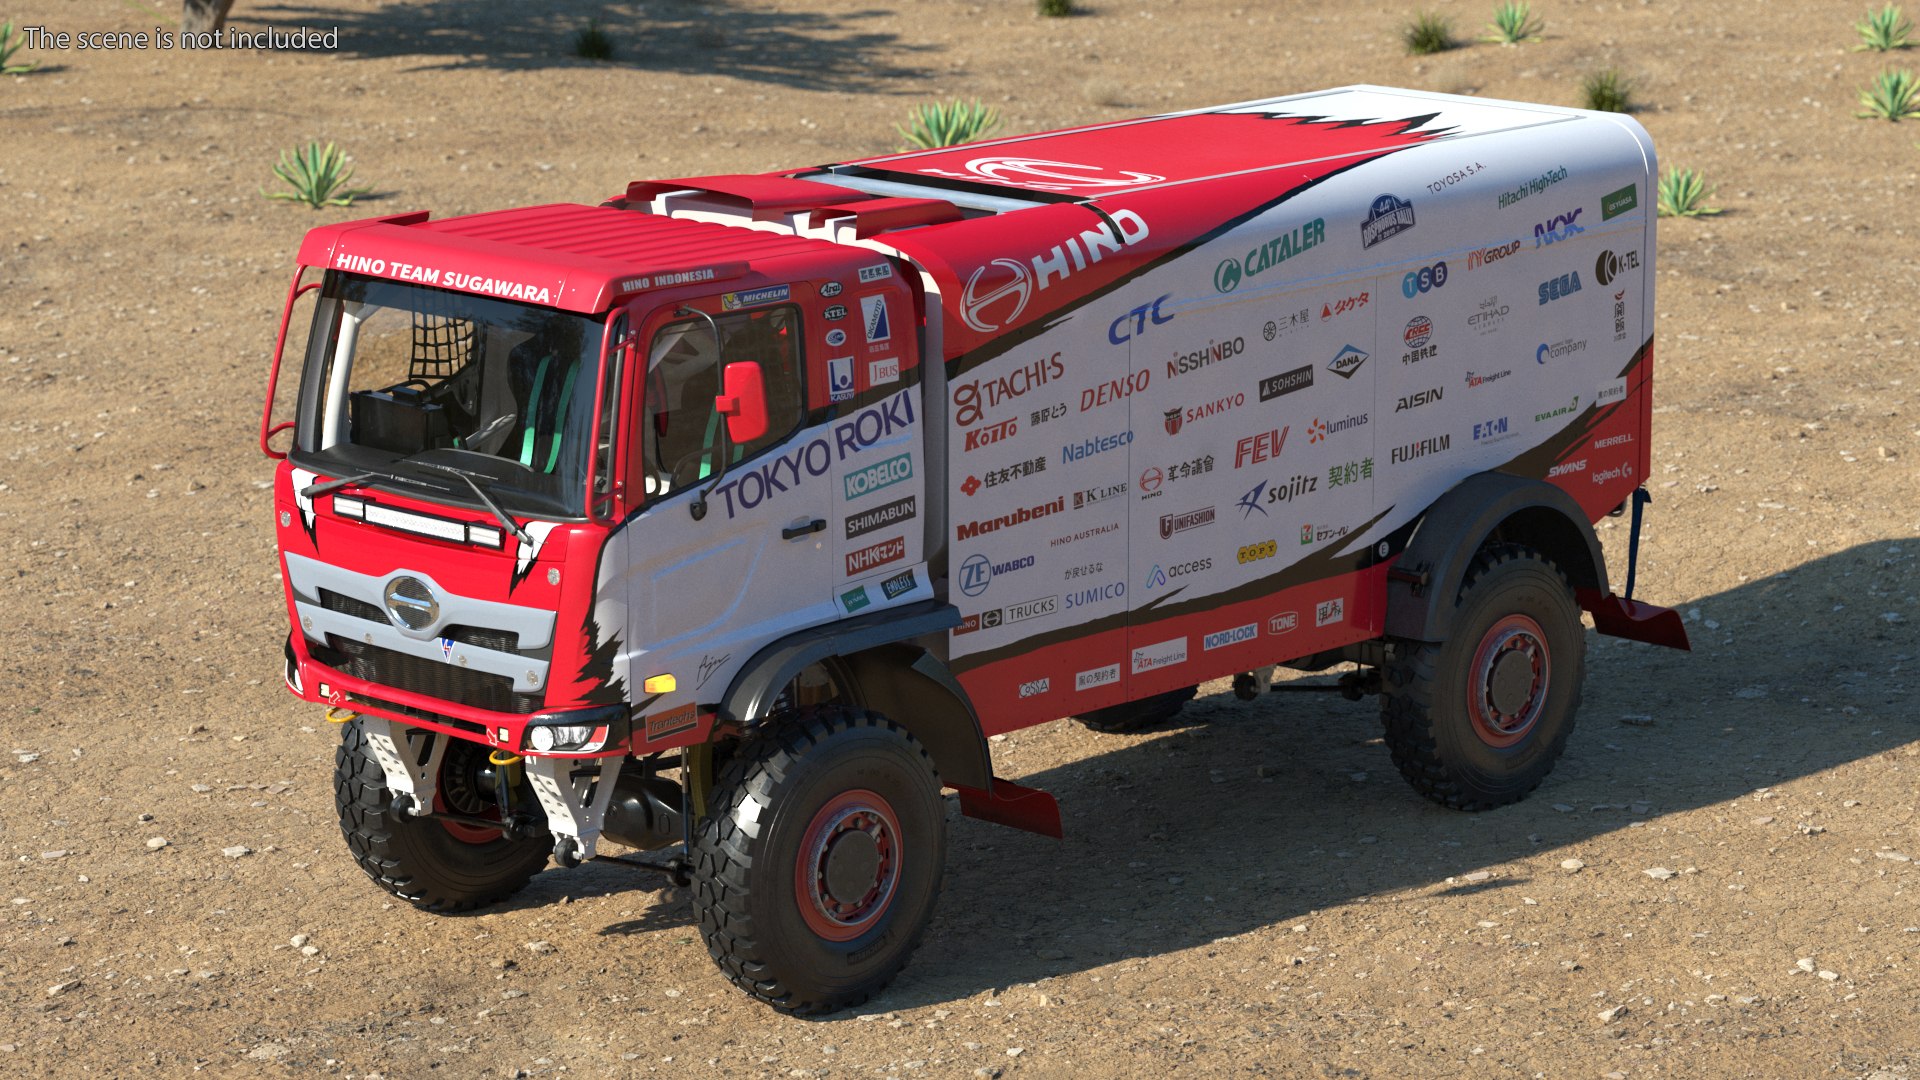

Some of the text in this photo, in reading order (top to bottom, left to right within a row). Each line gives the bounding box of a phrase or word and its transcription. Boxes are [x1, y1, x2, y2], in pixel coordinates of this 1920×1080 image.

[1427, 162, 1487, 194] TOYOSA S.A.
[1498, 183, 1528, 210] Hitachi
[1031, 208, 1149, 291] HINO
[1244, 217, 1325, 277] CATALER
[1618, 249, 1639, 274] K-TEL
[336, 253, 550, 304] HINO TEAM SUGAWARA
[622, 268, 715, 292] HINO INDONESIA
[1538, 270, 1582, 306] SEGA
[742, 287, 789, 303] MICHELIN
[1108, 292, 1175, 346] CTC
[1467, 305, 1510, 326] ETIHAD
[1335, 355, 1360, 369] DANA
[1550, 339, 1587, 359] company
[879, 364, 898, 379] BUS
[983, 351, 1065, 408] TACHI-S
[1271, 368, 1312, 393] SOHSHIN
[1468, 376, 1483, 389] ATA
[1080, 368, 1150, 412] DENSO
[1395, 386, 1444, 413] AISIN
[1186, 392, 1245, 424] SANKYO
[1326, 413, 1368, 435] luminus
[716, 389, 915, 519] TOKYO ROKI
[1062, 430, 1134, 464] Nabtesco
[1234, 425, 1290, 469] FEV
[1391, 434, 1450, 465] FUJIFILM
[1594, 433, 1633, 449] MERRELL
[845, 457, 911, 497] KOBELCO
[984, 456, 1047, 488] 住友不動産
[1328, 457, 1374, 490] 契約者
[1547, 459, 1588, 478] SWANS
[1592, 466, 1620, 485] logitech
[1101, 482, 1128, 498] LINE
[1141, 490, 1163, 501] HINO
[1268, 475, 1318, 504] sojitz
[848, 501, 914, 533] SHIMABUN
[956, 495, 1065, 541] Marubeni
[1174, 508, 1215, 531] UNIFASHION
[1050, 522, 1119, 548] HINO AUSTRALIA
[992, 555, 1035, 576] WABCO
[1168, 557, 1212, 578] access
[1065, 582, 1125, 609] SUMICO
[1009, 599, 1055, 620] TRUCKS
[1270, 614, 1296, 632] TONE
[1204, 624, 1256, 649] NORD-LOCK
[1137, 652, 1186, 669] ATA Freight Line
